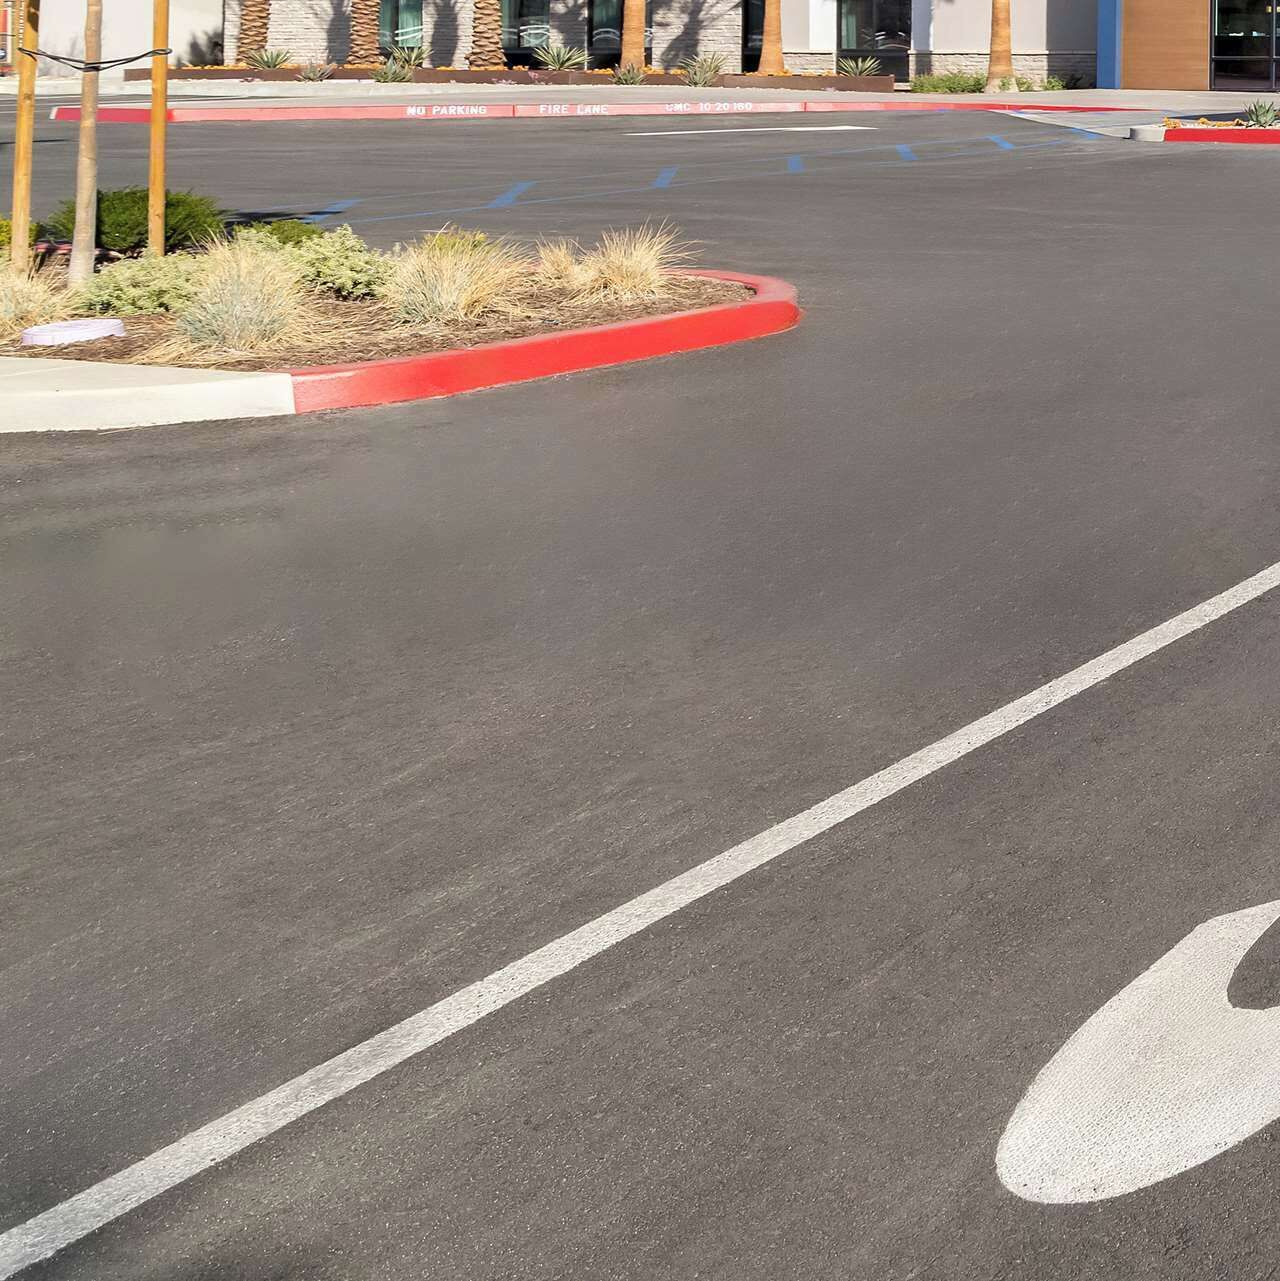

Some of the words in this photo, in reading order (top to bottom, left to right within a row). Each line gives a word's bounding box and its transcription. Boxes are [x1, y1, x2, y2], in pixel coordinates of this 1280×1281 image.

[432, 105, 487, 115] PARKING
[540, 104, 568, 114] FIRE
[577, 104, 609, 114] LANE
